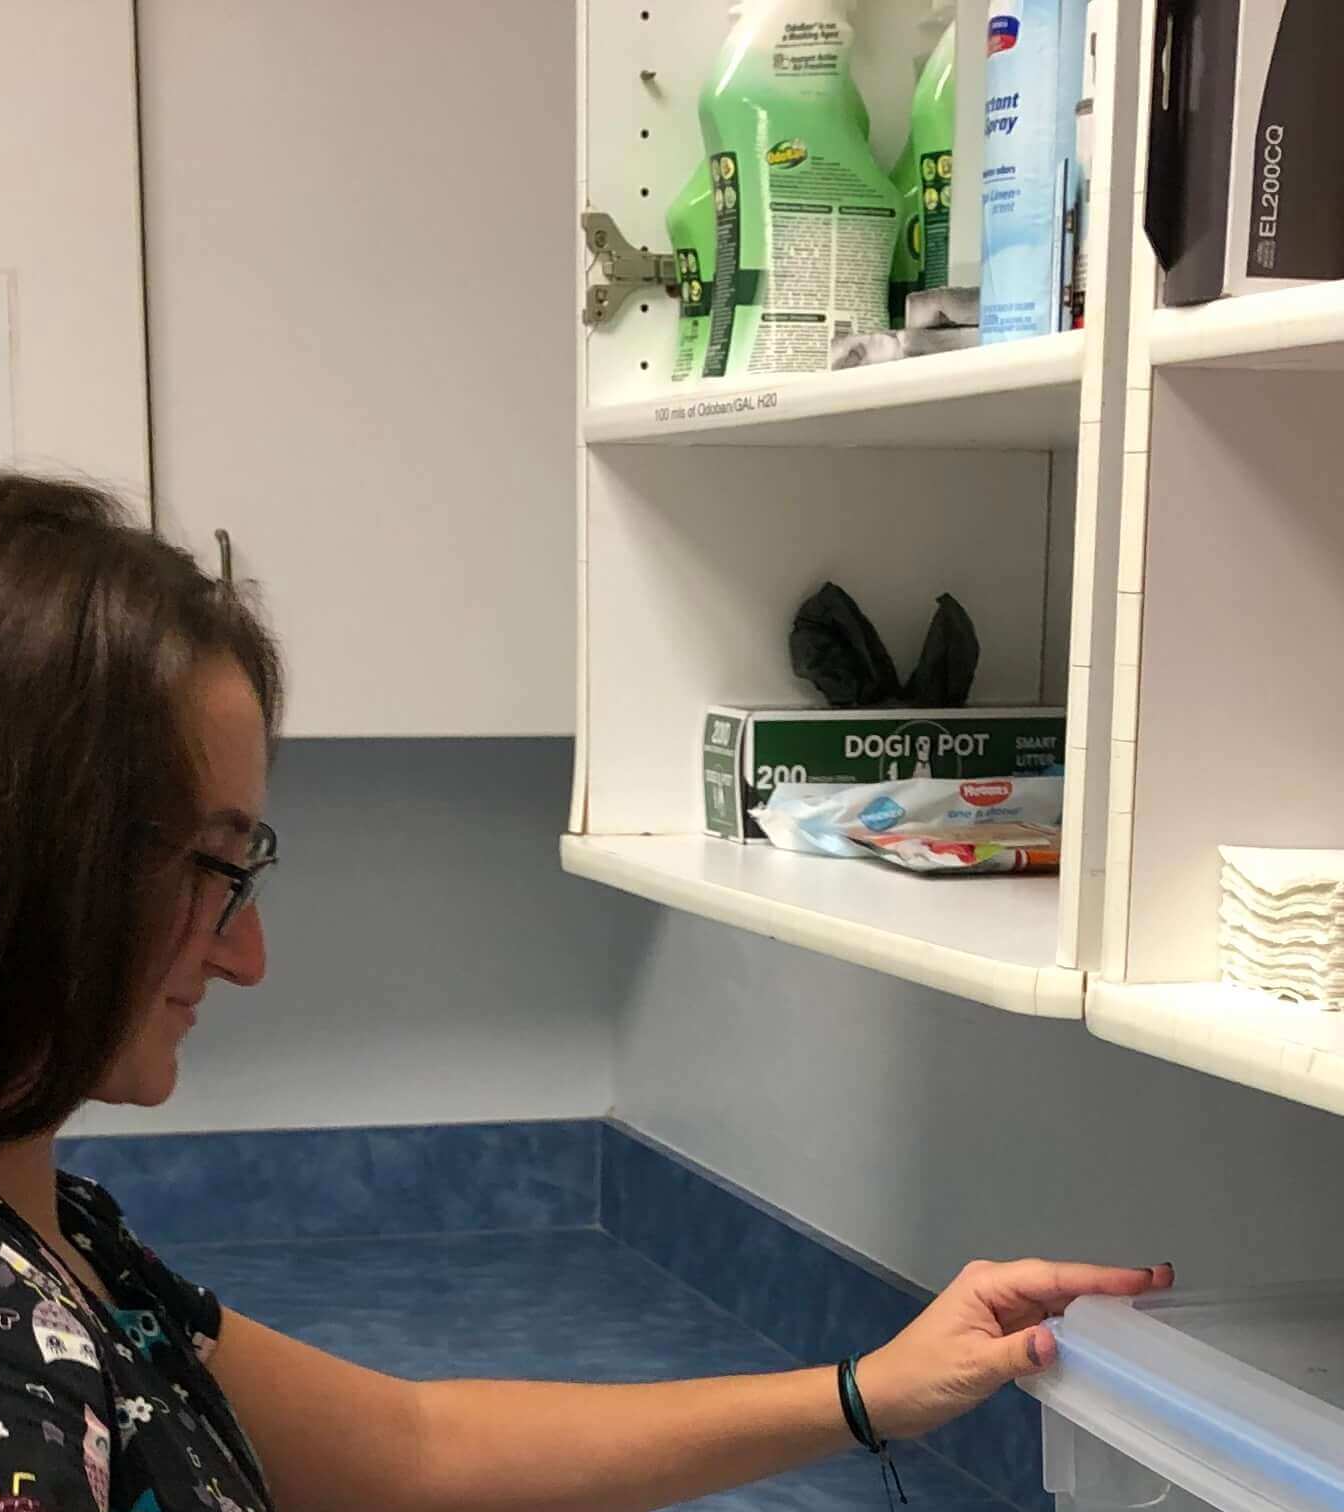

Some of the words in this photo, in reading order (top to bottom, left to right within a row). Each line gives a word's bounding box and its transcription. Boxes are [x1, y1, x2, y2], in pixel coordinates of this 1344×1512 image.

[1259, 124, 1285, 238] EL200CQ
[654, 408, 670, 422] 100
[687, 406, 696, 419] of
[844, 734, 911, 758] DOGI
[937, 733, 990, 757] POT
[1015, 736, 1057, 751] SMART
[1015, 753, 1055, 767] LITTER
[757, 764, 807, 790] 200
